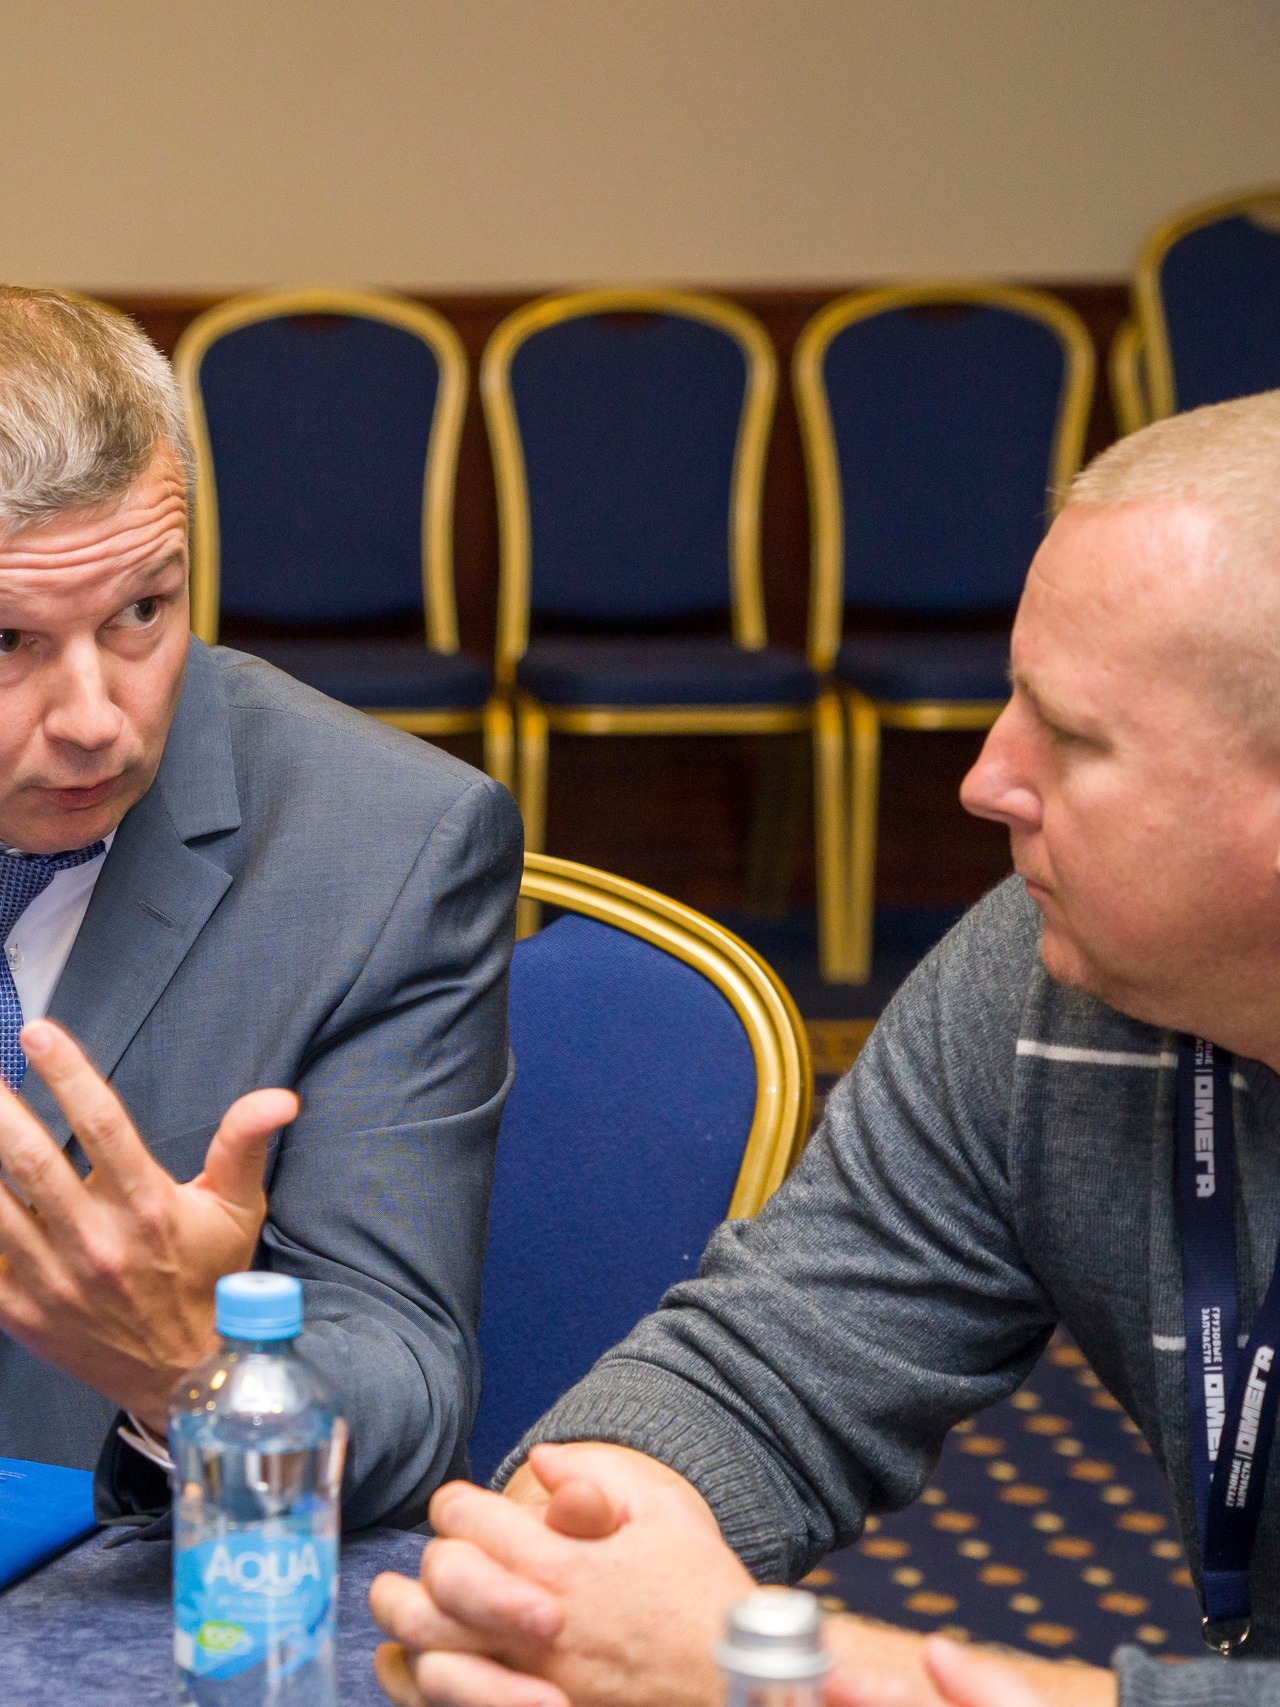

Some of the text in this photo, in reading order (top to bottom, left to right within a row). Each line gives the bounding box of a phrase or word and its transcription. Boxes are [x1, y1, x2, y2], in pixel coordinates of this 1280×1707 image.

[1194, 1075, 1216, 1198] ОМЕГА
[1201, 1307, 1212, 1364] ЗАПЧАСТИ
[1211, 1306, 1223, 1363] ГРУЗОВЫЕ
[1235, 1345, 1275, 1455] ОМЕГА
[203, 1544, 321, 1594] AQUA
